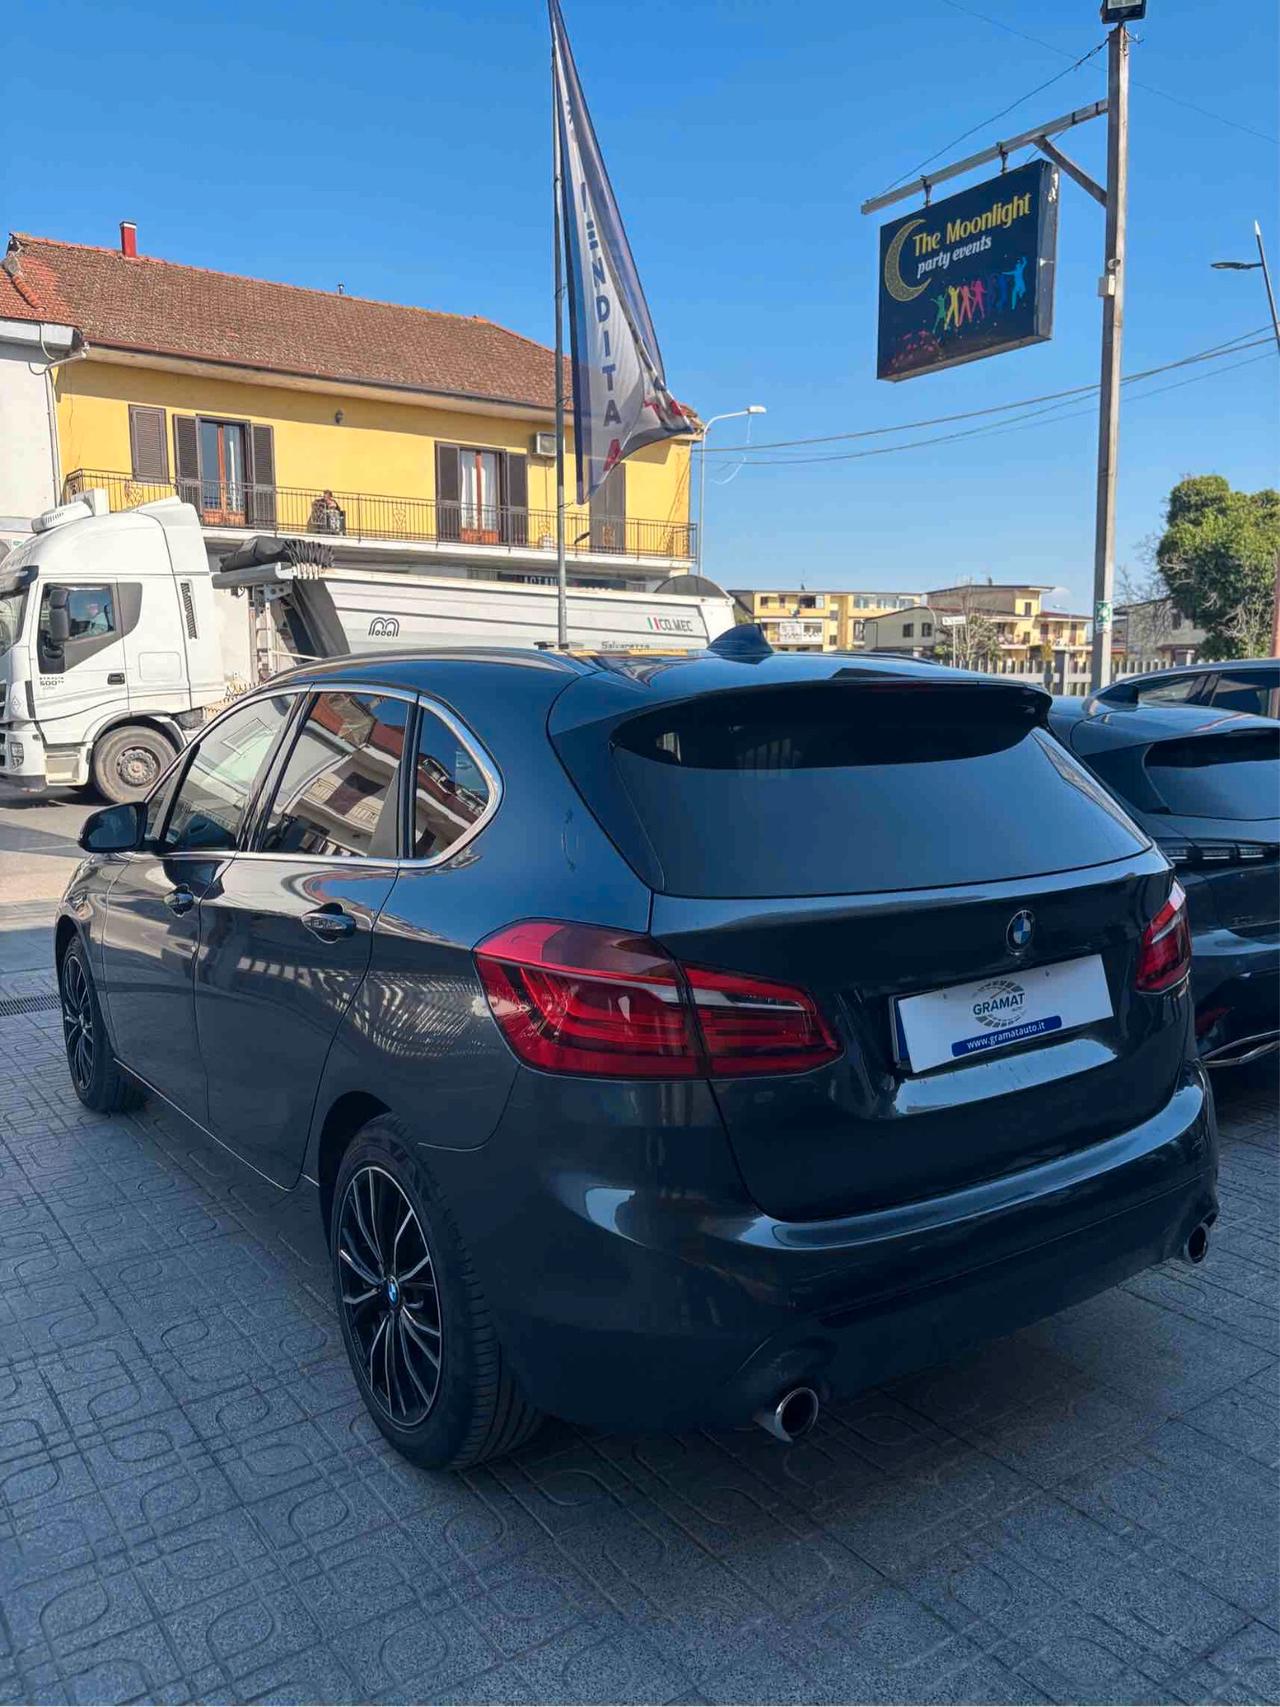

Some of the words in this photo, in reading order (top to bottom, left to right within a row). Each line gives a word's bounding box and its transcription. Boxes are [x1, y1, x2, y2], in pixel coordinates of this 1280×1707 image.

[912, 231, 941, 257] The
[946, 192, 1032, 244] Moonlight
[917, 250, 952, 279] party
[952, 235, 992, 260] events
[972, 992, 1026, 1015] GRAMAT
[966, 1021, 1046, 1050] www.gramatauto.it
